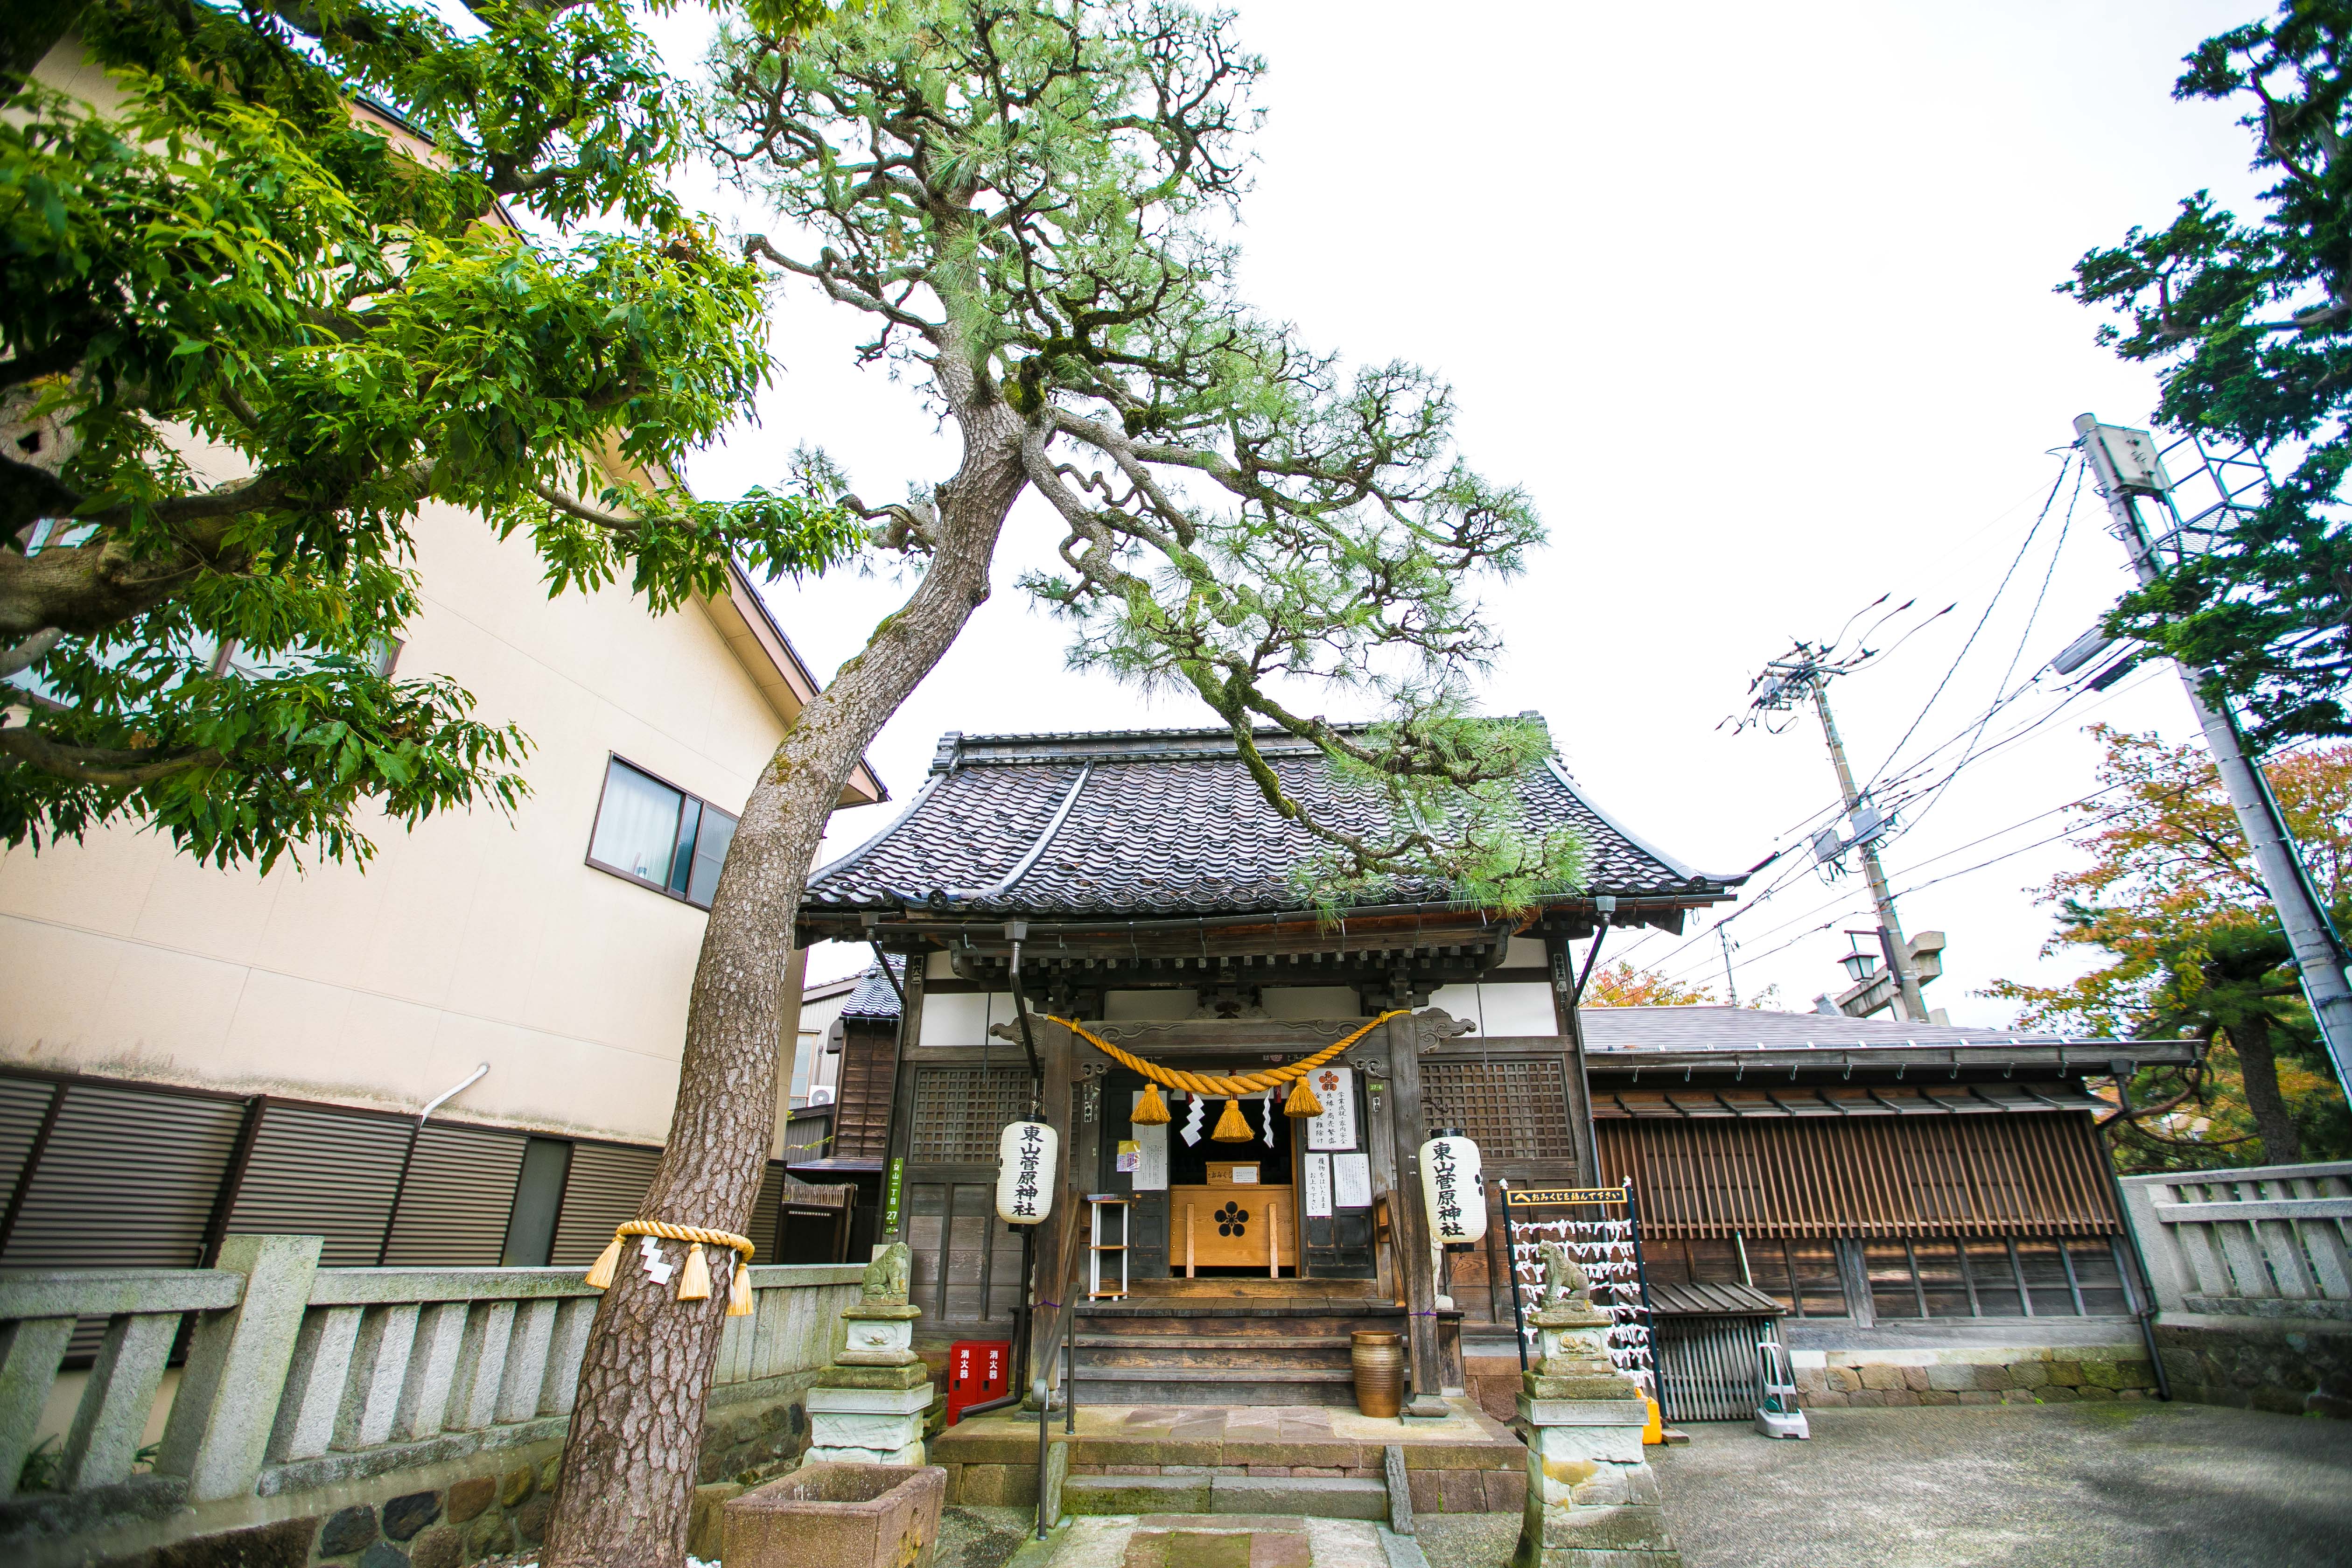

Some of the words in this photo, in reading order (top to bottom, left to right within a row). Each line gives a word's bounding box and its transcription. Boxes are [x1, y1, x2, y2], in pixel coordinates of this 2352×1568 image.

[890, 1164, 900, 1205] 東山一丁目
[1012, 1125, 1044, 1217] 東山菅原神社
[1432, 1141, 1466, 1237] 東山菅原神社
[886, 1211, 897, 1220] 27
[960, 1349, 970, 1379] 消火器
[989, 1350, 998, 1379] 消火器
